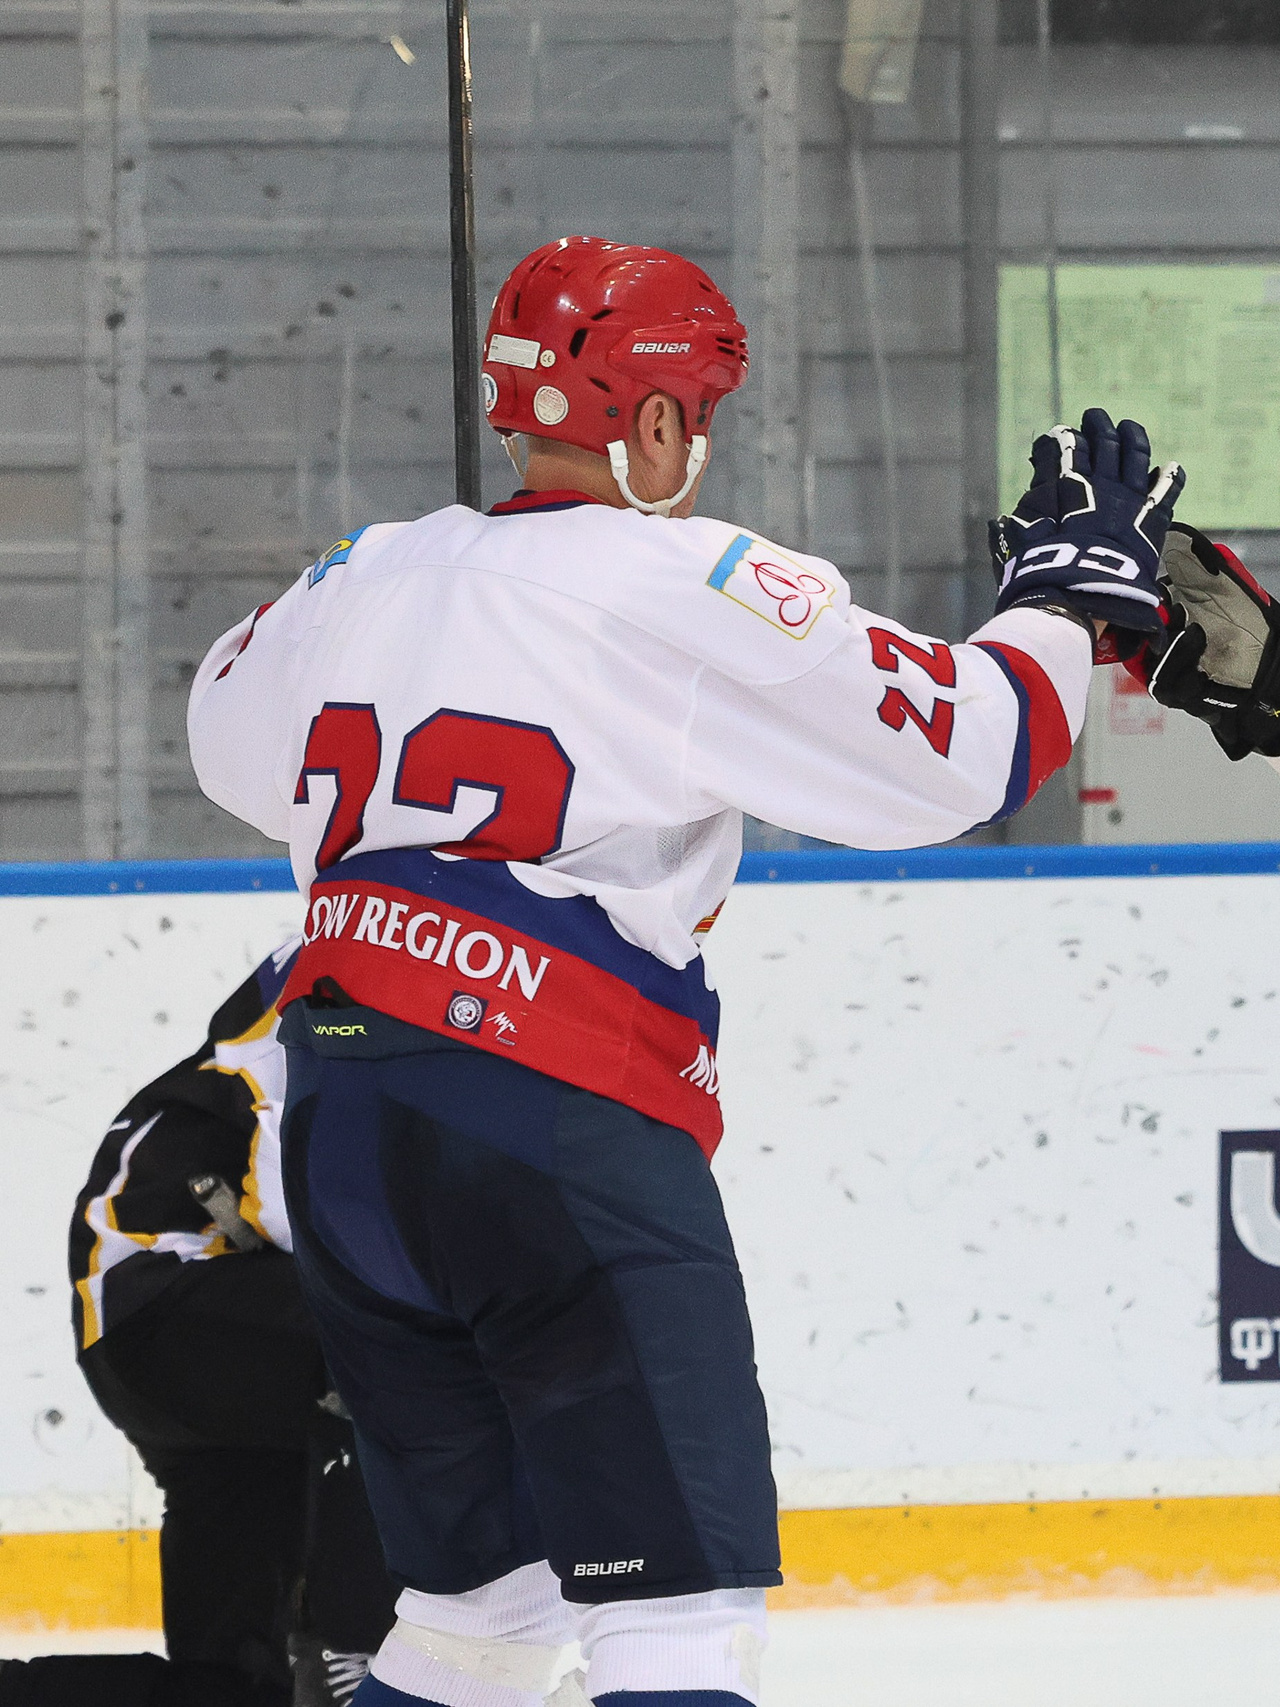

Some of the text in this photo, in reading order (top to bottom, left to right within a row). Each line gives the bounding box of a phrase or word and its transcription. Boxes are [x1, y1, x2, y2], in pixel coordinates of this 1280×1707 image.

[632, 342, 691, 354] BAUER
[866, 626, 957, 760] 22
[352, 895, 552, 1002] REGION
[311, 1024, 368, 1036] VAPOR
[573, 1558, 645, 1577] BAUER
